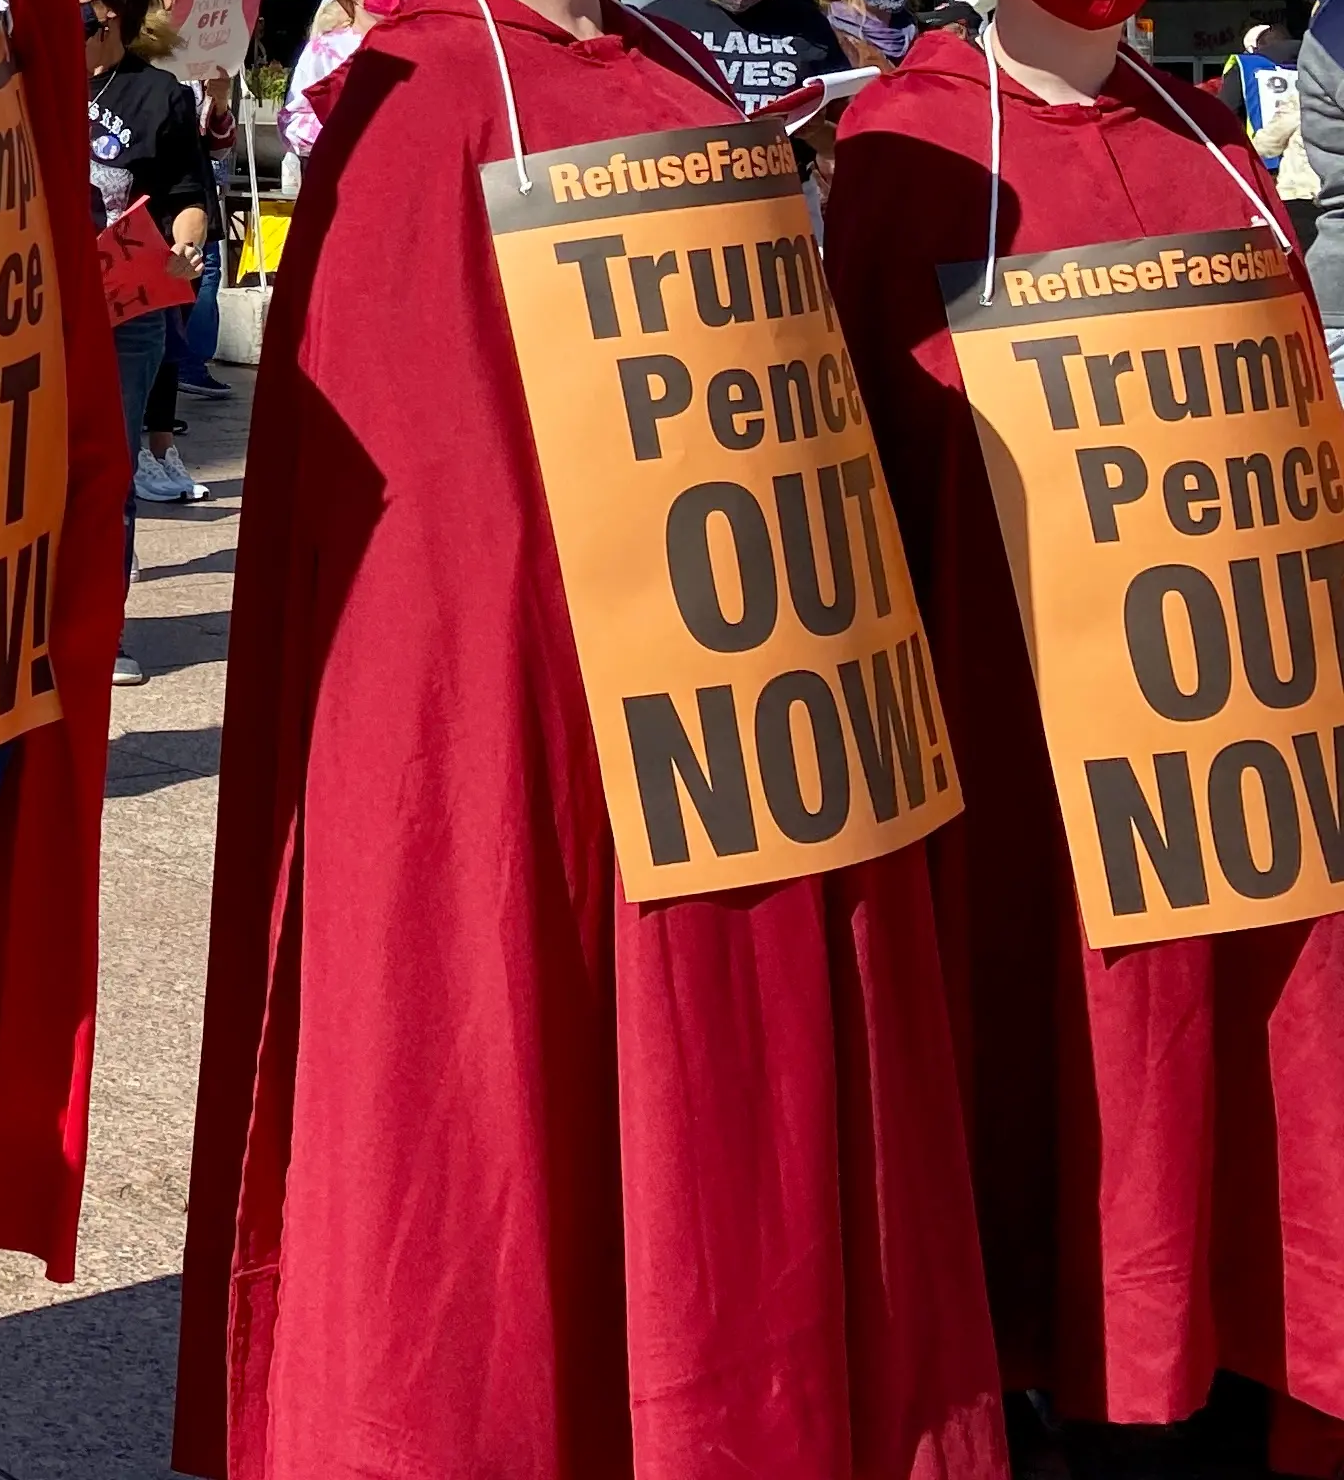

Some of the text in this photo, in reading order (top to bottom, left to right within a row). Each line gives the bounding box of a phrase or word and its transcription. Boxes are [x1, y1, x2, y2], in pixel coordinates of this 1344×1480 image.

[197, 8, 229, 29] OFF
[691, 30, 798, 55] LACK
[549, 135, 799, 204] RefuseFascis
[616, 346, 863, 462] Pence
[1074, 439, 1344, 544] Pence
[664, 454, 894, 654] OUT
[1123, 540, 1344, 723] OUT
[621, 631, 949, 867] NOW!
